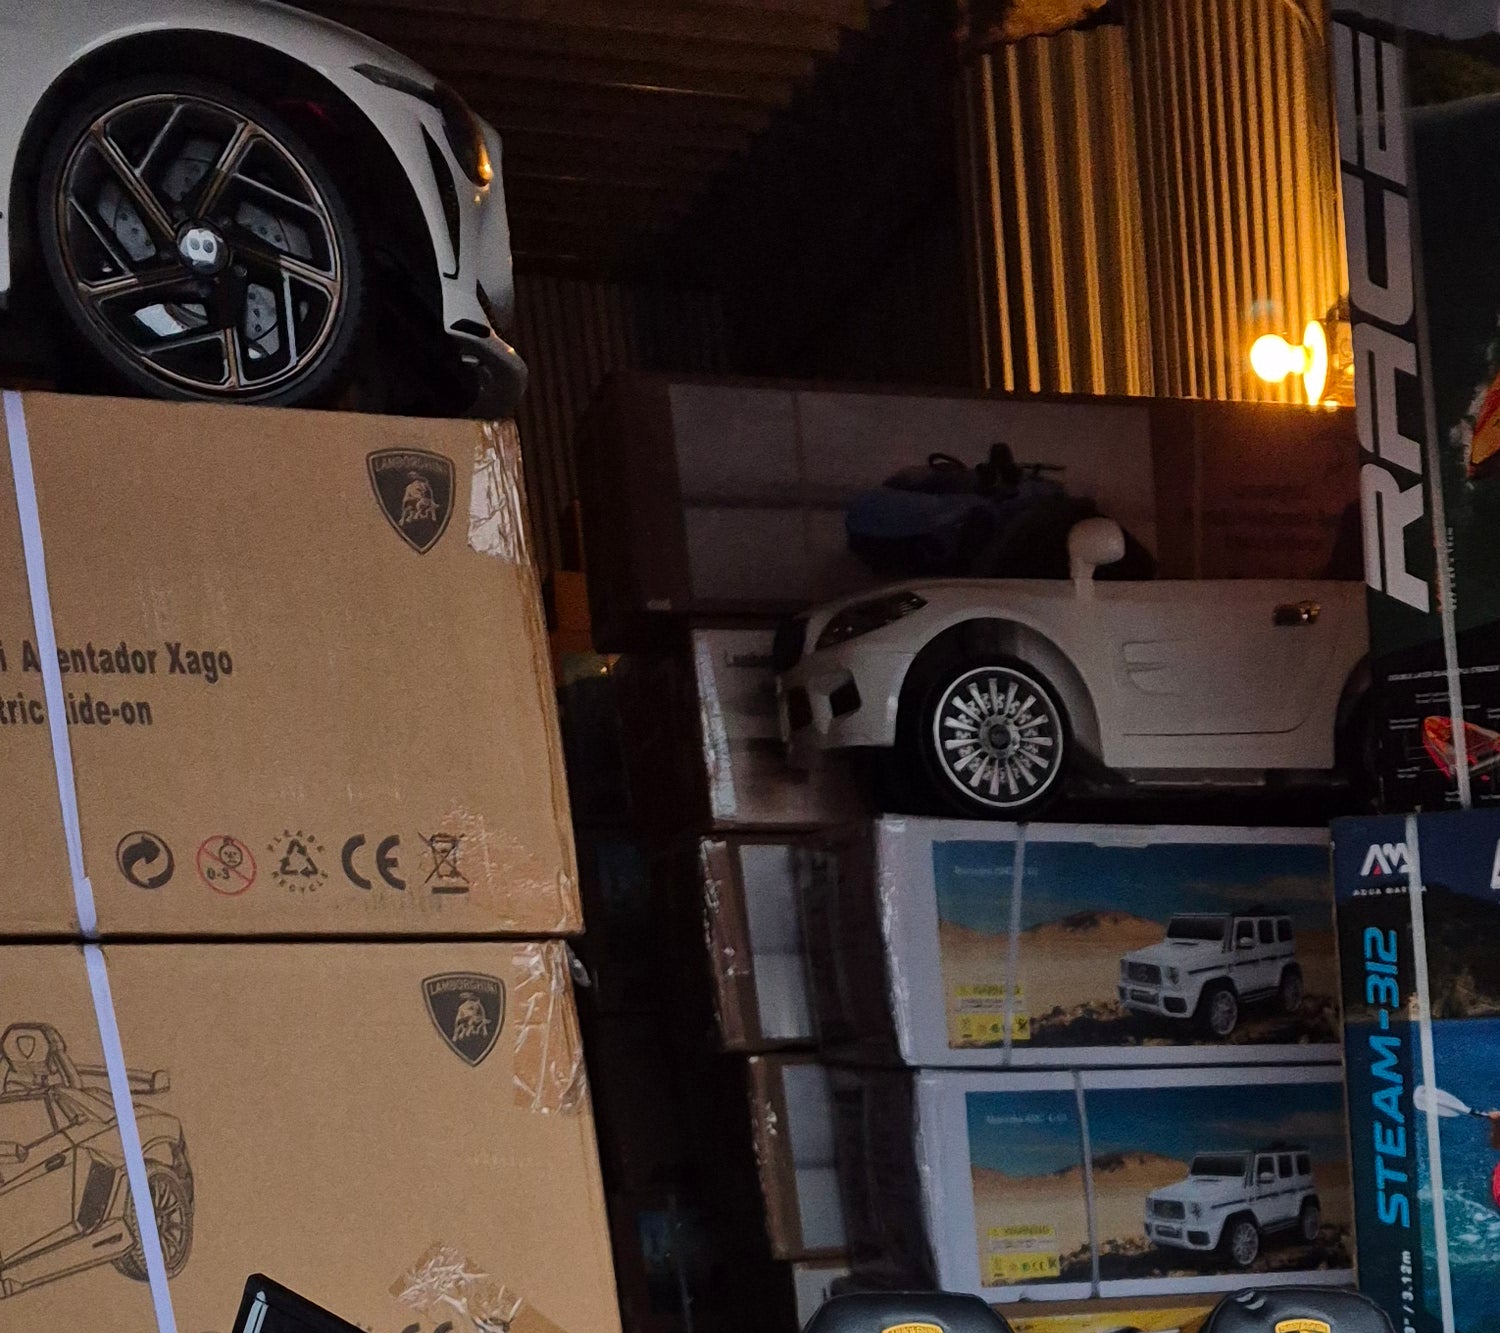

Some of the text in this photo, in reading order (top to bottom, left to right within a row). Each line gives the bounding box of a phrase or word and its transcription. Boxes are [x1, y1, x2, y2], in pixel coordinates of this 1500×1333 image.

[1331, 18, 1430, 613] RACE
[22, 640, 157, 675] Aentador
[164, 641, 233, 684] Xago
[67, 692, 154, 725] ide-on
[1364, 926, 1410, 1229] STEAM-312
